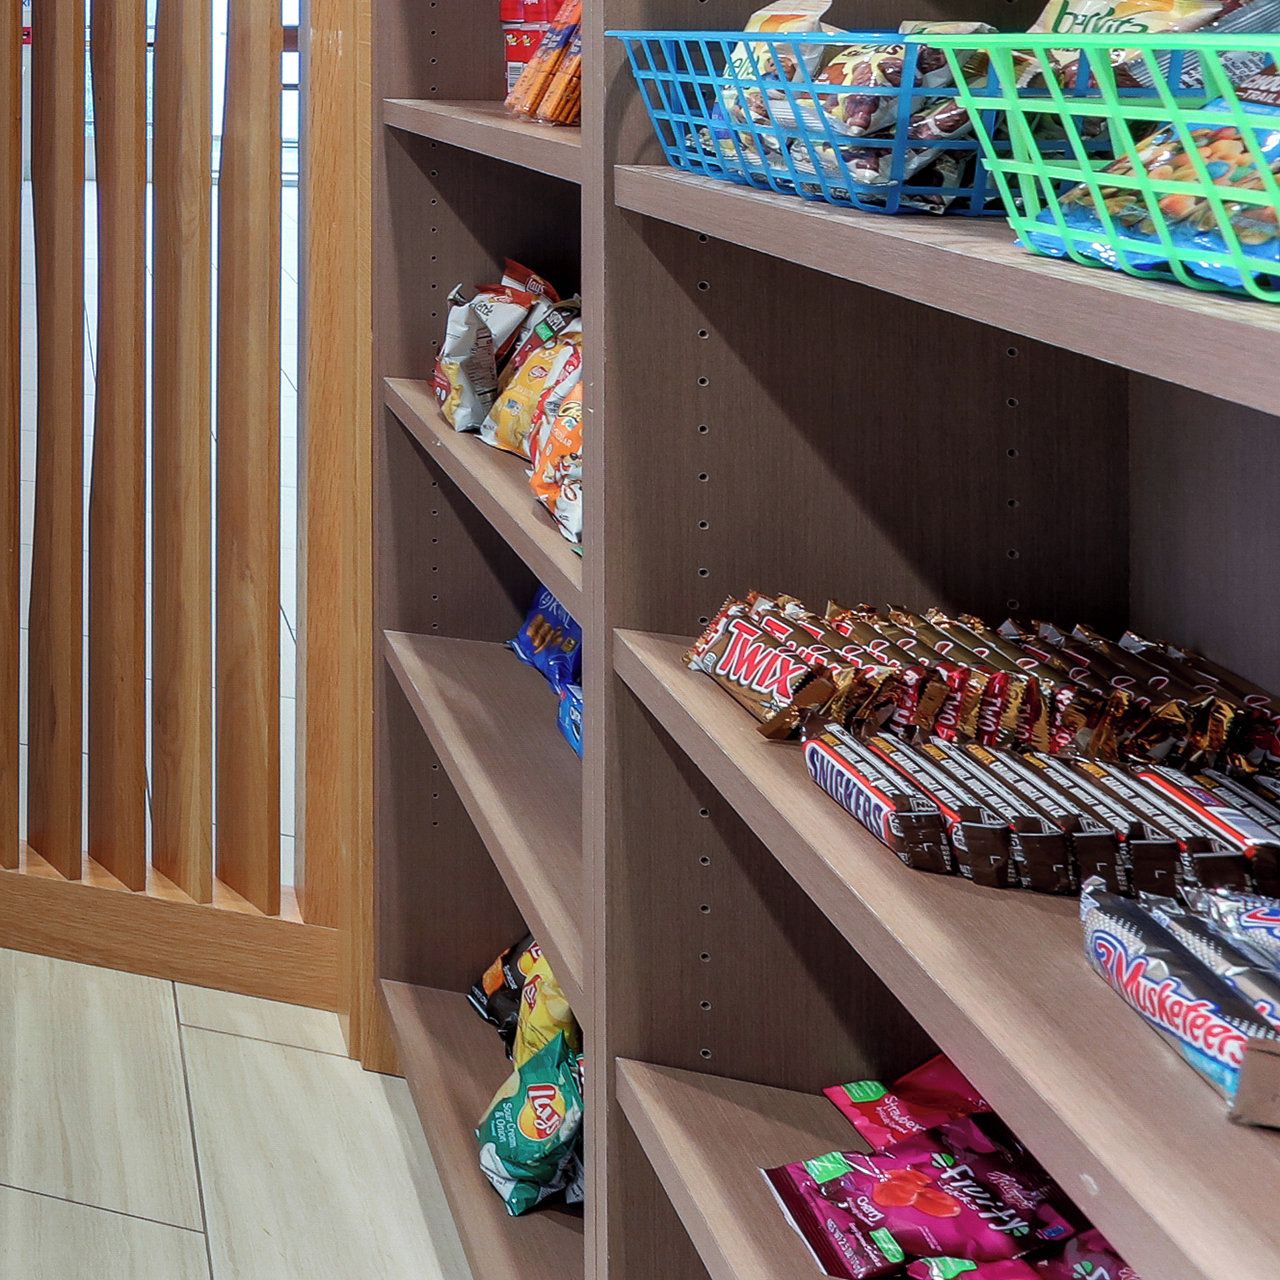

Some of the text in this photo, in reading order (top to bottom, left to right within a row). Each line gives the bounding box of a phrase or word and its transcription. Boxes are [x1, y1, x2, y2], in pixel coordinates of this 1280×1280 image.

[717, 619, 811, 708] TWIX
[807, 744, 885, 840] SNICKERS
[1114, 949, 1249, 1066] Musketeers
[496, 1119, 507, 1143] Onion
[503, 1102, 517, 1148] Sour Cream
[857, 1196, 885, 1221] Cherry
[940, 1164, 1029, 1231] Fruity
